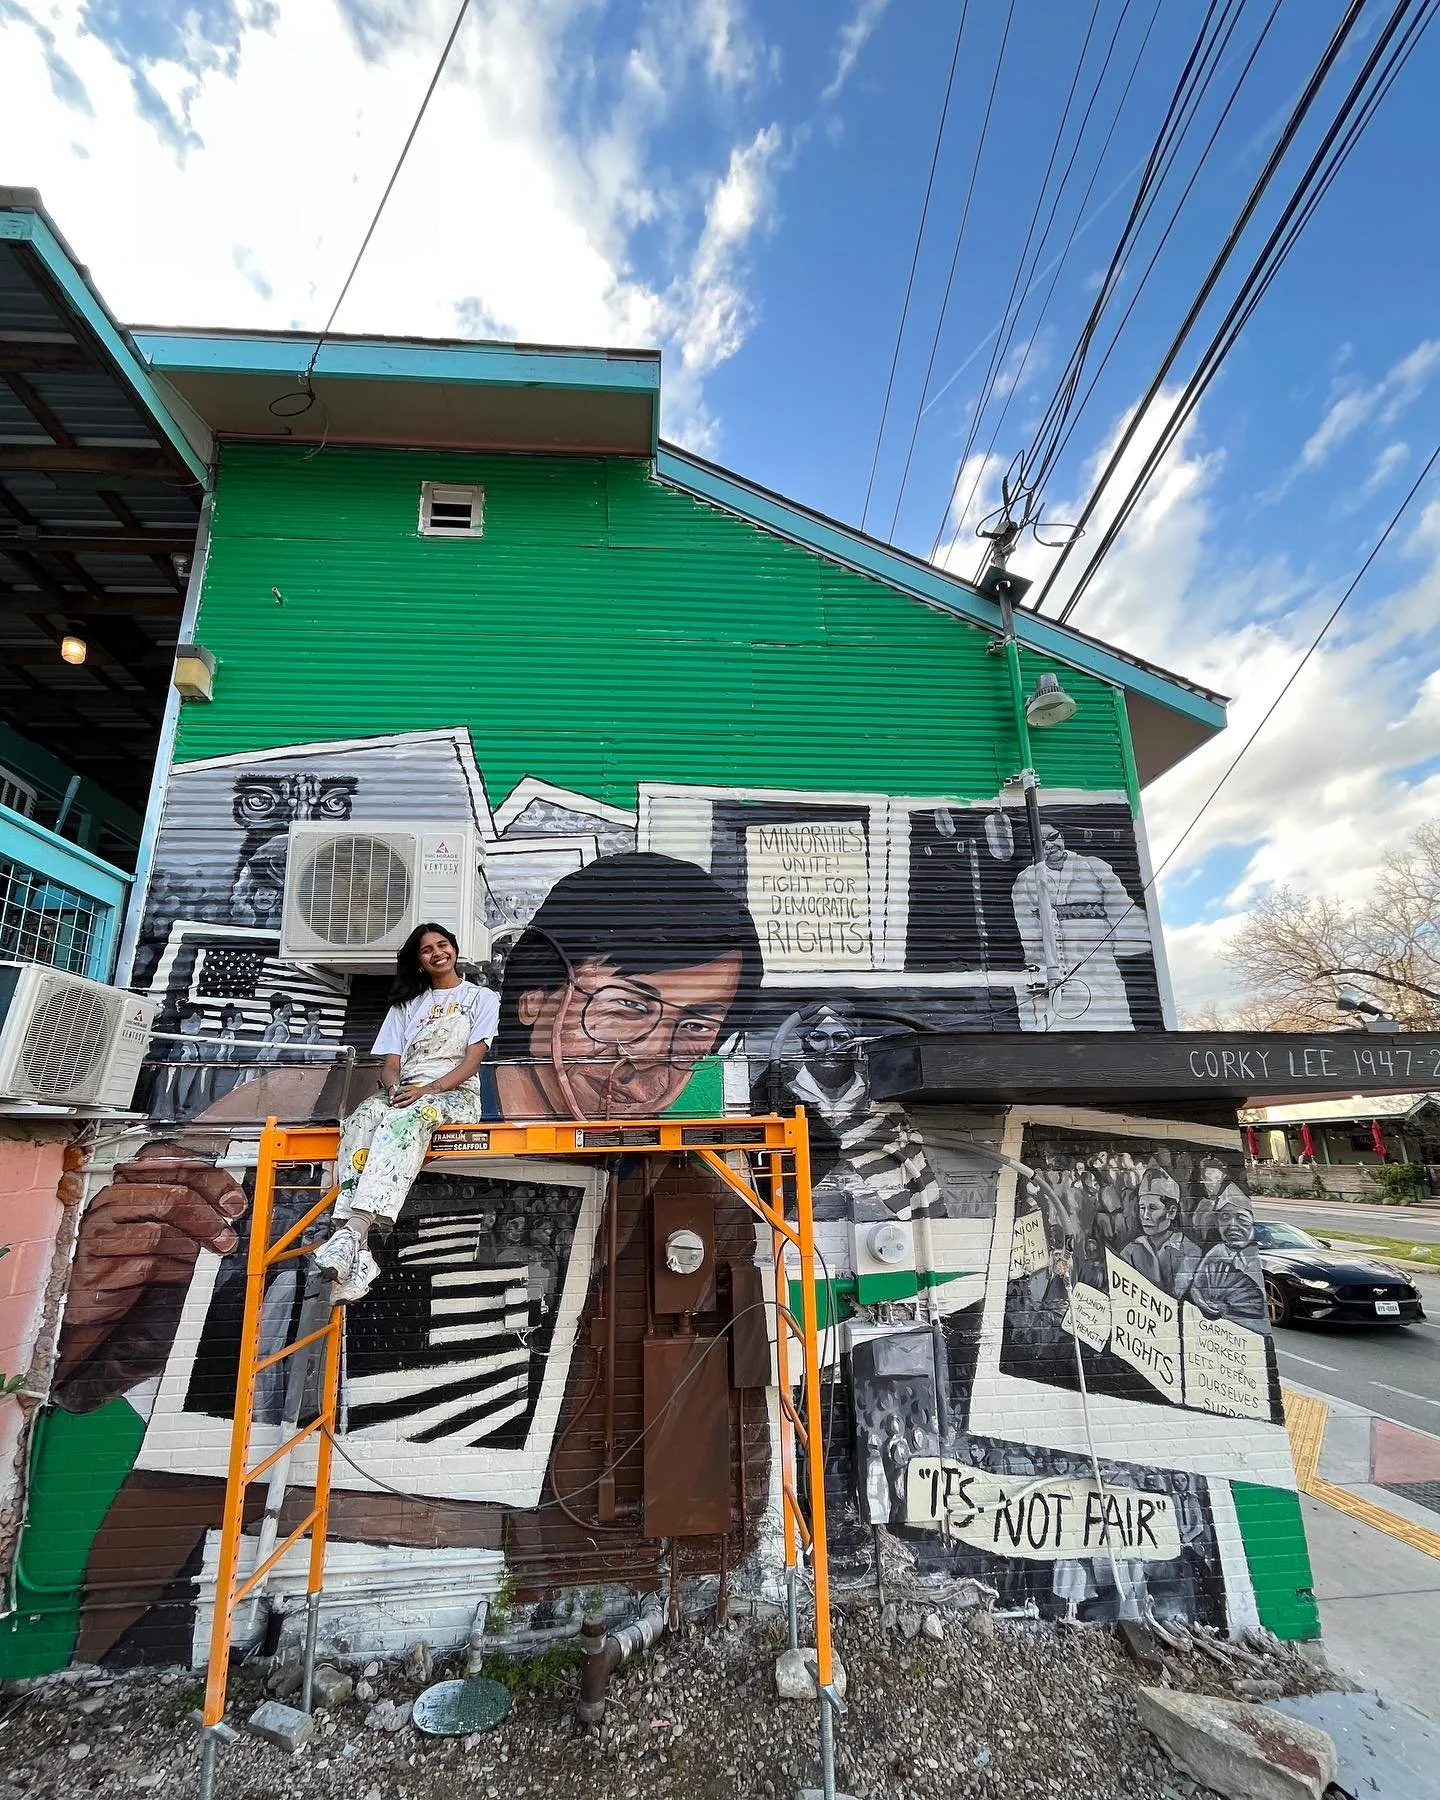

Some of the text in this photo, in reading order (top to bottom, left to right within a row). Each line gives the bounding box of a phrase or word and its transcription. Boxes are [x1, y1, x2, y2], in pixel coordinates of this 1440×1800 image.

[760, 826, 863, 854] MINORITIES
[782, 856, 840, 873] UNITE!
[762, 875, 856, 893] FIGHT FOR
[771, 895, 860, 918] DEMOCRATIC
[767, 920, 864, 954] RIGHTS
[1189, 1050, 1270, 1079] CORKY
[1289, 1049, 1338, 1078] LEE
[434, 1132, 467, 1142] FRANKLIN
[1086, 1298, 1106, 1313] UNION
[1112, 1270, 1173, 1322] DEFEND
[1126, 1308, 1156, 1337] OUR
[1199, 1319, 1247, 1350] GARMENT
[1115, 1325, 1173, 1385] RIGHTS
[1198, 1336, 1247, 1366] WORKERS
[1198, 1373, 1259, 1408] OURSELVES
[1220, 1363, 1257, 1389] DEFEND
[994, 1489, 1072, 1550] NOT
